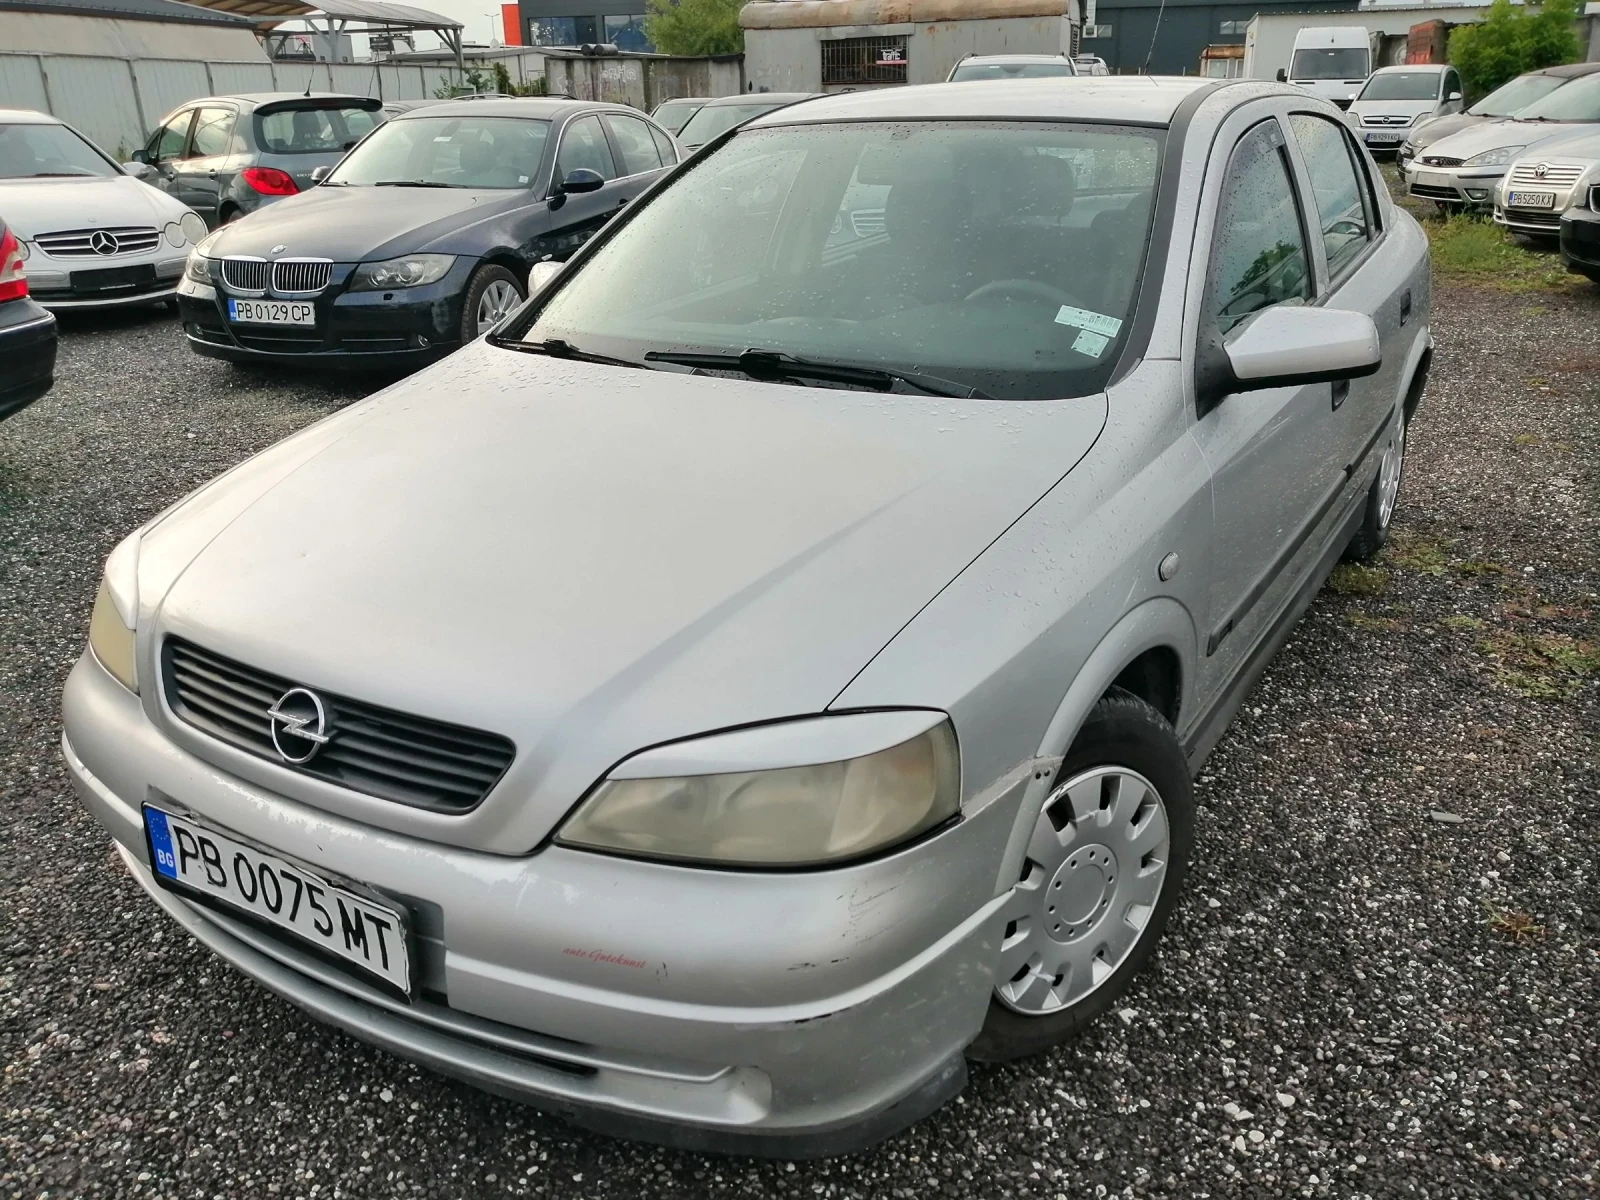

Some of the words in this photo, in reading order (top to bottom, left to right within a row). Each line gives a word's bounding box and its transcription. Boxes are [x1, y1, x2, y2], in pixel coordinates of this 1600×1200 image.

[1513, 193, 1522, 204] PB
[1522, 194, 1541, 205] 5250
[1541, 194, 1553, 206] KX
[236, 302, 253, 319] PB
[255, 304, 288, 321] 0129
[291, 305, 311, 322] CP
[157, 848, 175, 868] BG
[172, 824, 228, 888] PB
[233, 851, 334, 938] 0075
[336, 896, 392, 972] MT
